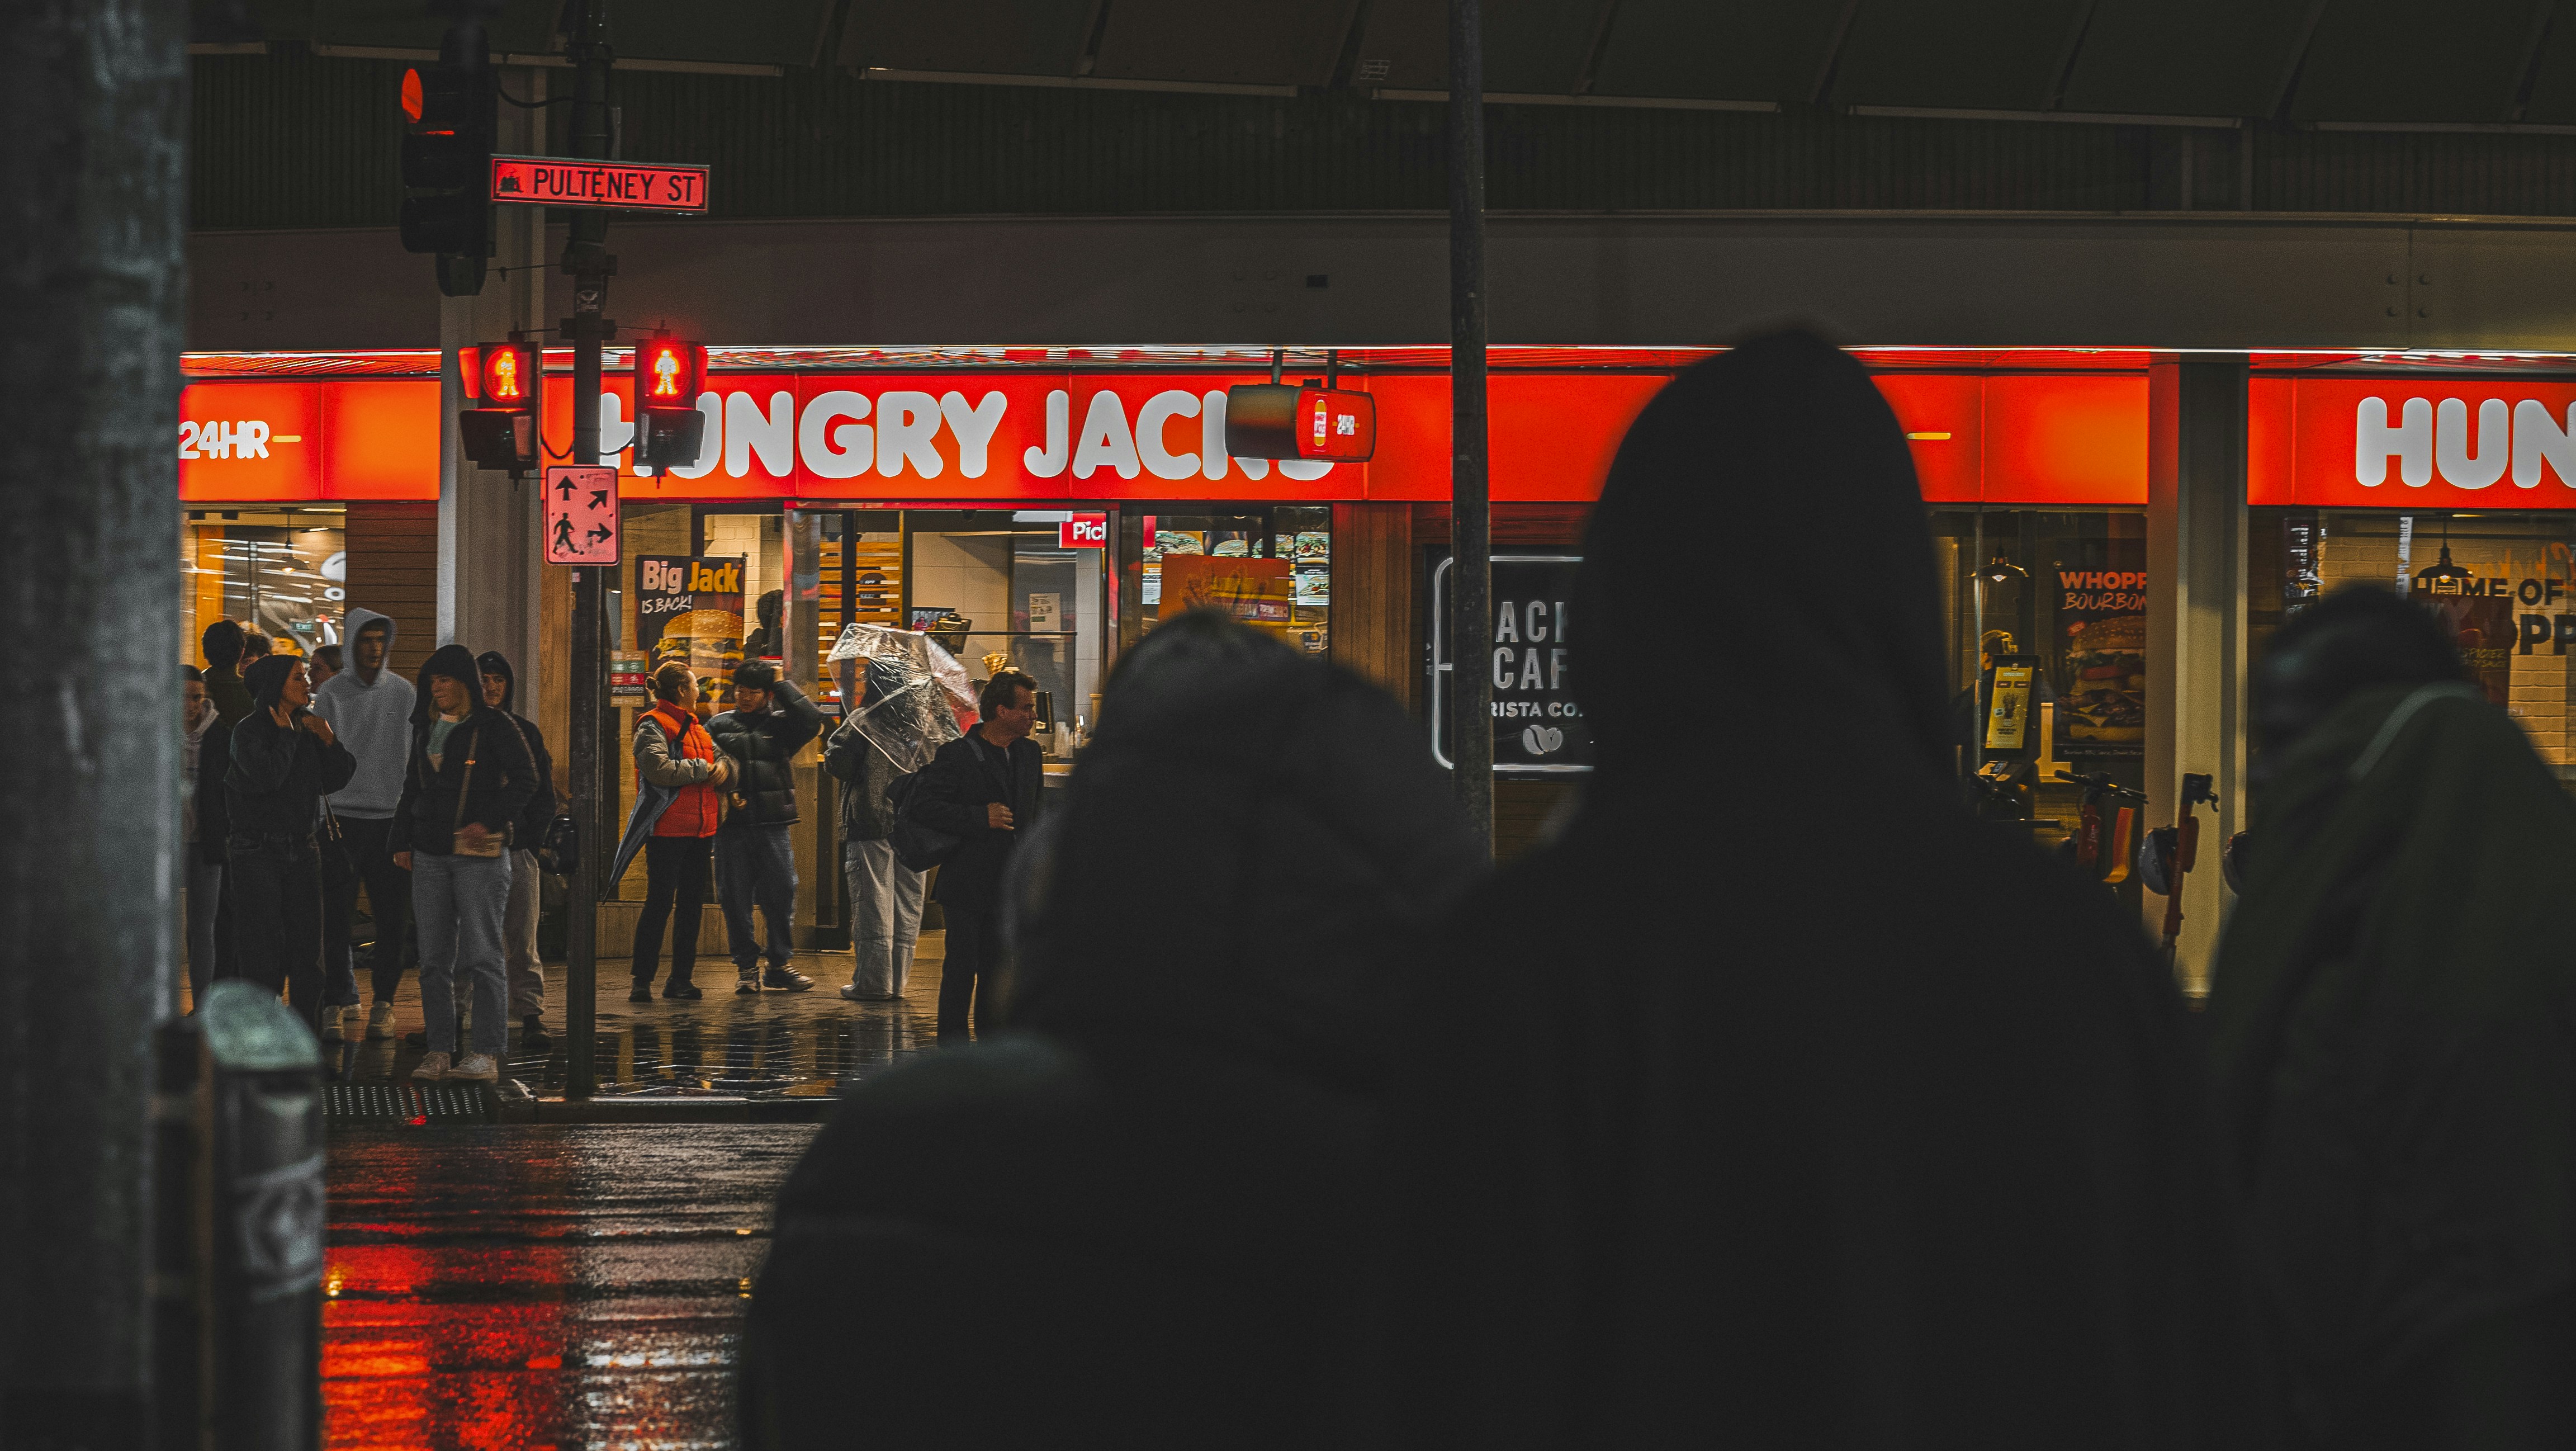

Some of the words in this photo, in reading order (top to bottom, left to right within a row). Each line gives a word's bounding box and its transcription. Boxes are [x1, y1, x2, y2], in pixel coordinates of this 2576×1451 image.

[534, 168, 656, 200] PULTENEY
[667, 175, 696, 202] ST
[178, 420, 269, 459] 24HR
[2356, 396, 2576, 489] HUN
[642, 560, 683, 594] Big
[688, 561, 740, 593] Jack
[2518, 578, 2565, 606] OF
[641, 599, 653, 614] IS
[654, 594, 692, 613] BACK!
[1547, 702, 1583, 717] CO.
